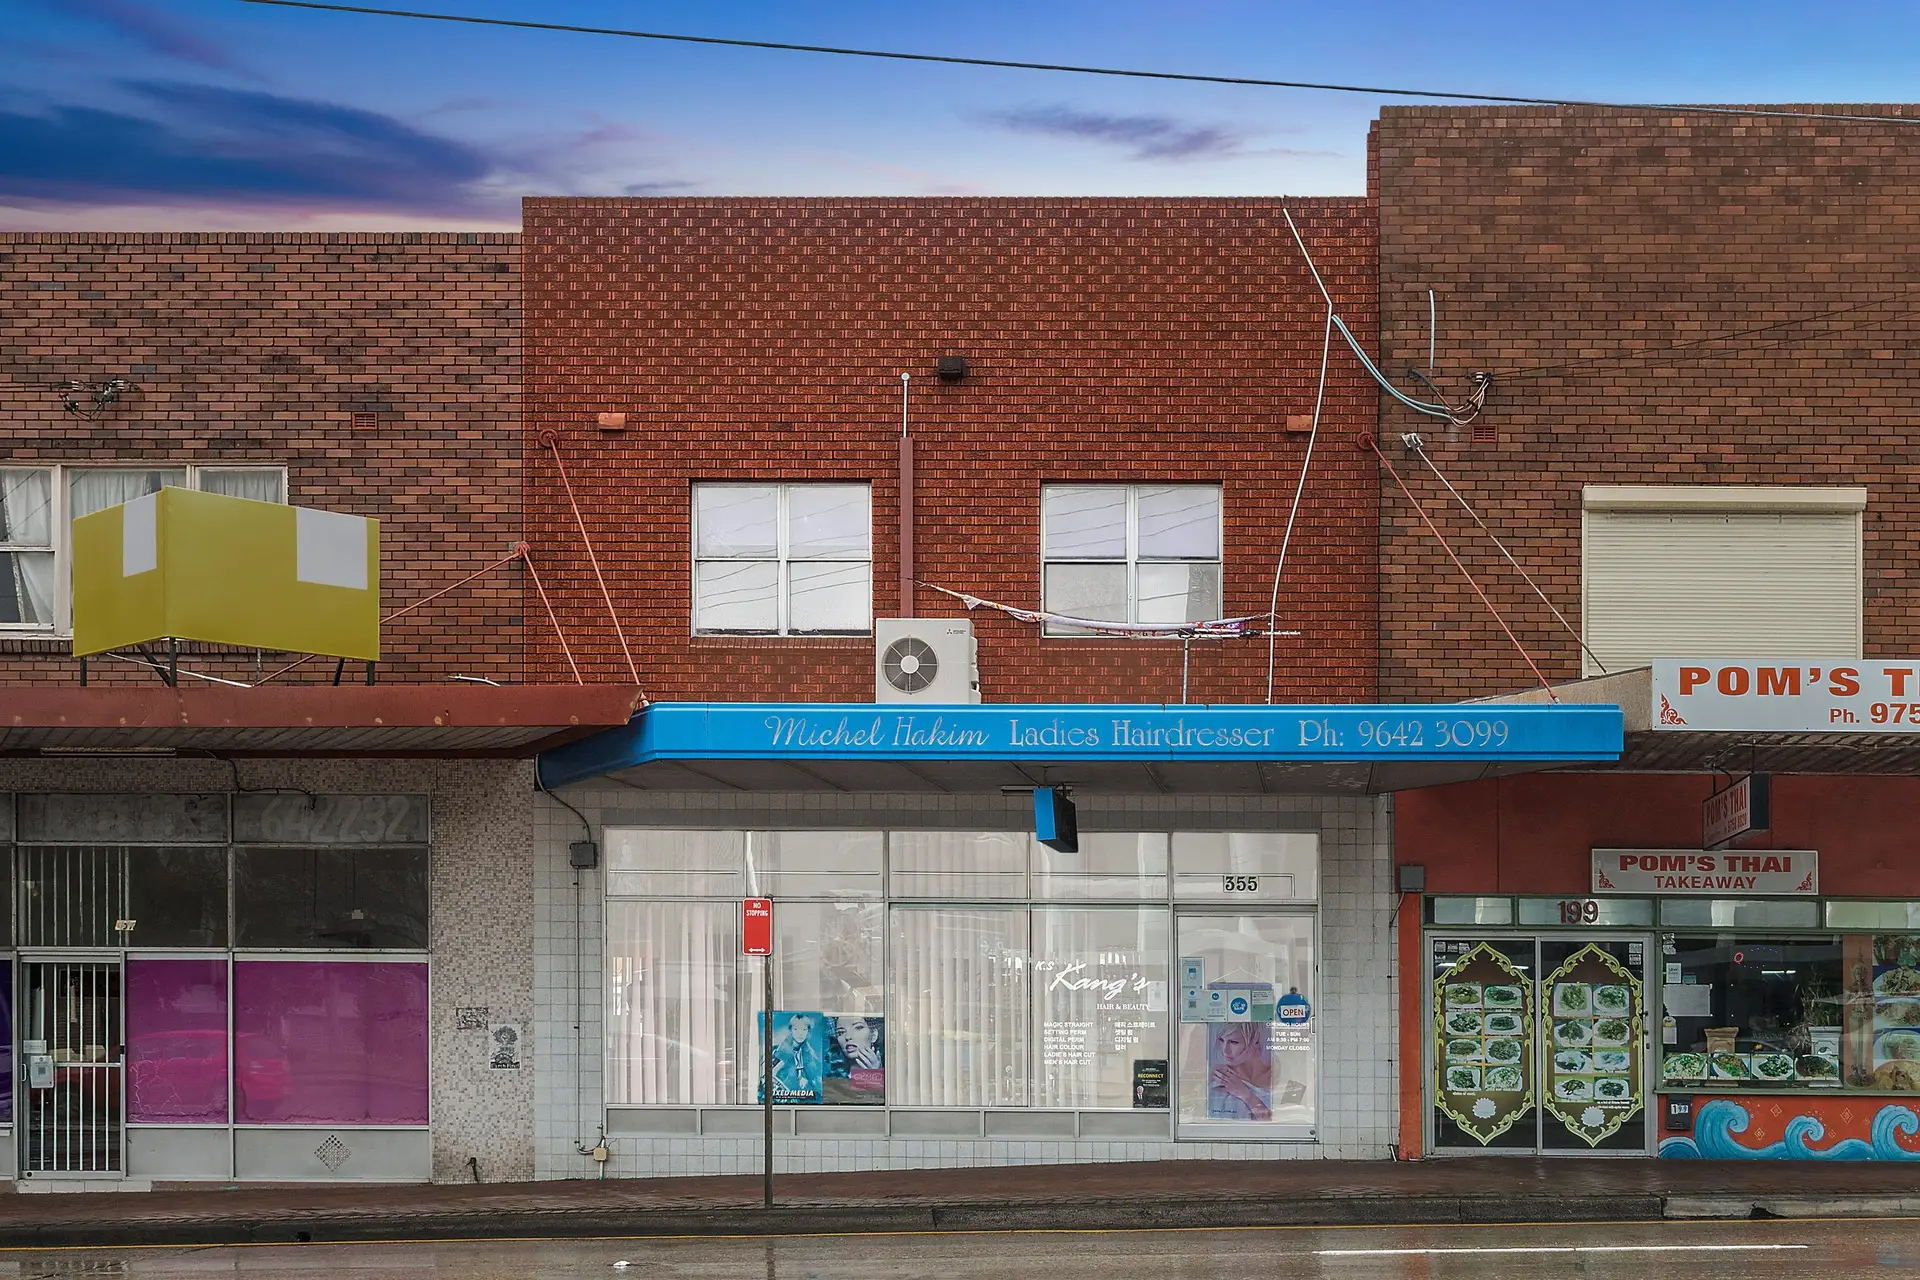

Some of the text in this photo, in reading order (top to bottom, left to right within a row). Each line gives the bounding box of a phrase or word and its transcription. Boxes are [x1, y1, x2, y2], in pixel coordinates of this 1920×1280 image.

[1680, 666, 1920, 697] POM'S T
[1830, 708, 1860, 723] Ph.
[764, 715, 1510, 748] Michel Hakim Ladies Hairdresser Ph: 9642 3099
[1706, 783, 1747, 828] POM'S THAI
[1619, 855, 1792, 873] POM'S THAI
[1225, 875, 1258, 892] 355
[1653, 875, 1757, 889] TAKEAWAY
[746, 909, 769, 917] STOPPING
[1557, 900, 1599, 924] 199
[1049, 959, 1152, 1001] Kang's
[1282, 1008, 1304, 1017] OPEN
[1671, 1103, 1689, 1113] 199
